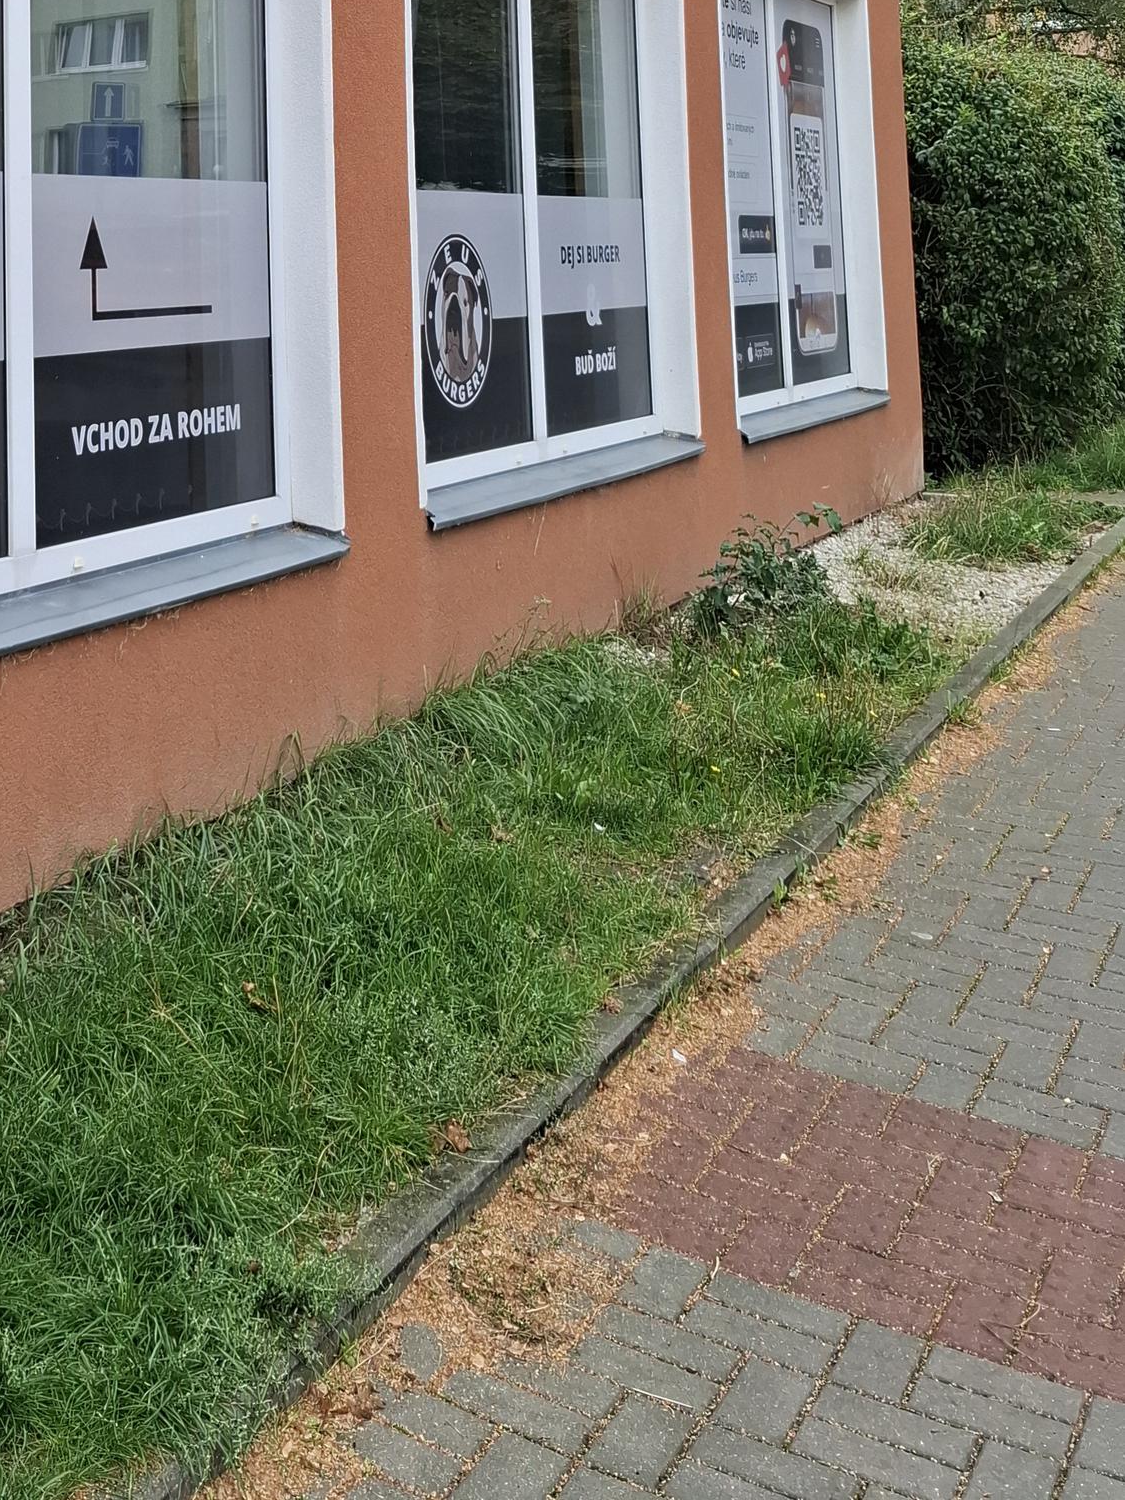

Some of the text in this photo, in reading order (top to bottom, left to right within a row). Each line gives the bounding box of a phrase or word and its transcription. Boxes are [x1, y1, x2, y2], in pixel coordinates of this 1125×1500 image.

[727, 20, 759, 48] objevujte
[728, 47, 746, 70] které
[430, 243, 484, 291] ZEUS
[560, 244, 621, 269] DEJ SI BURGER
[586, 283, 603, 327] &
[575, 345, 617, 376] BUĎ BOŽÍ
[435, 359, 485, 403] BURGERS
[71, 403, 241, 456] VCHOD ZA ROHEM
